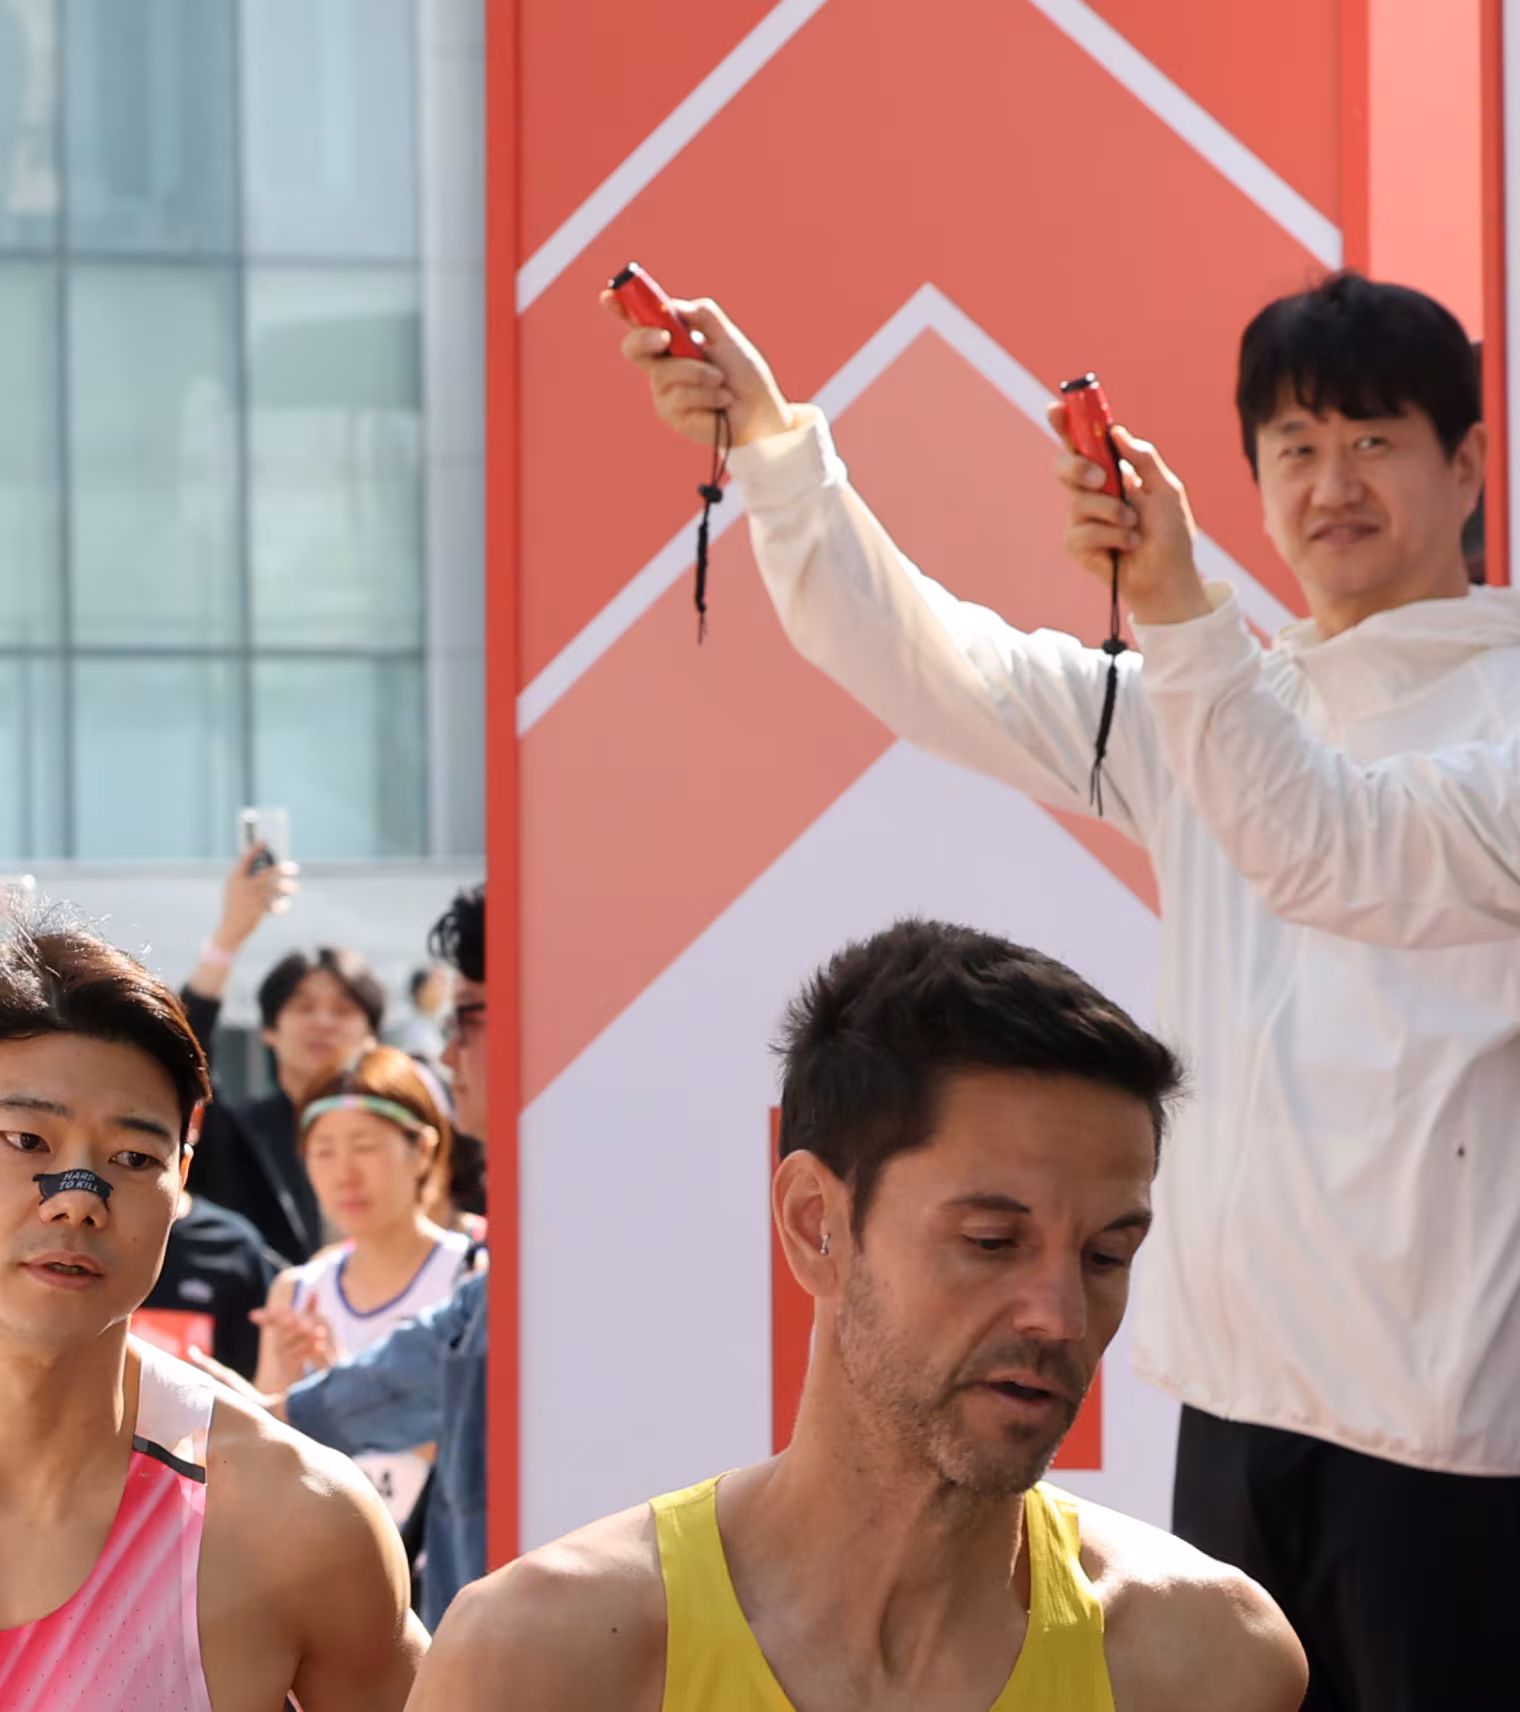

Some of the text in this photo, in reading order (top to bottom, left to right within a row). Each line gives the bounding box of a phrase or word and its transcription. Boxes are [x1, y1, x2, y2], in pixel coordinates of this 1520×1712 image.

[63, 1171, 96, 1181] HARD
[59, 1180, 99, 1192] TO KILL
